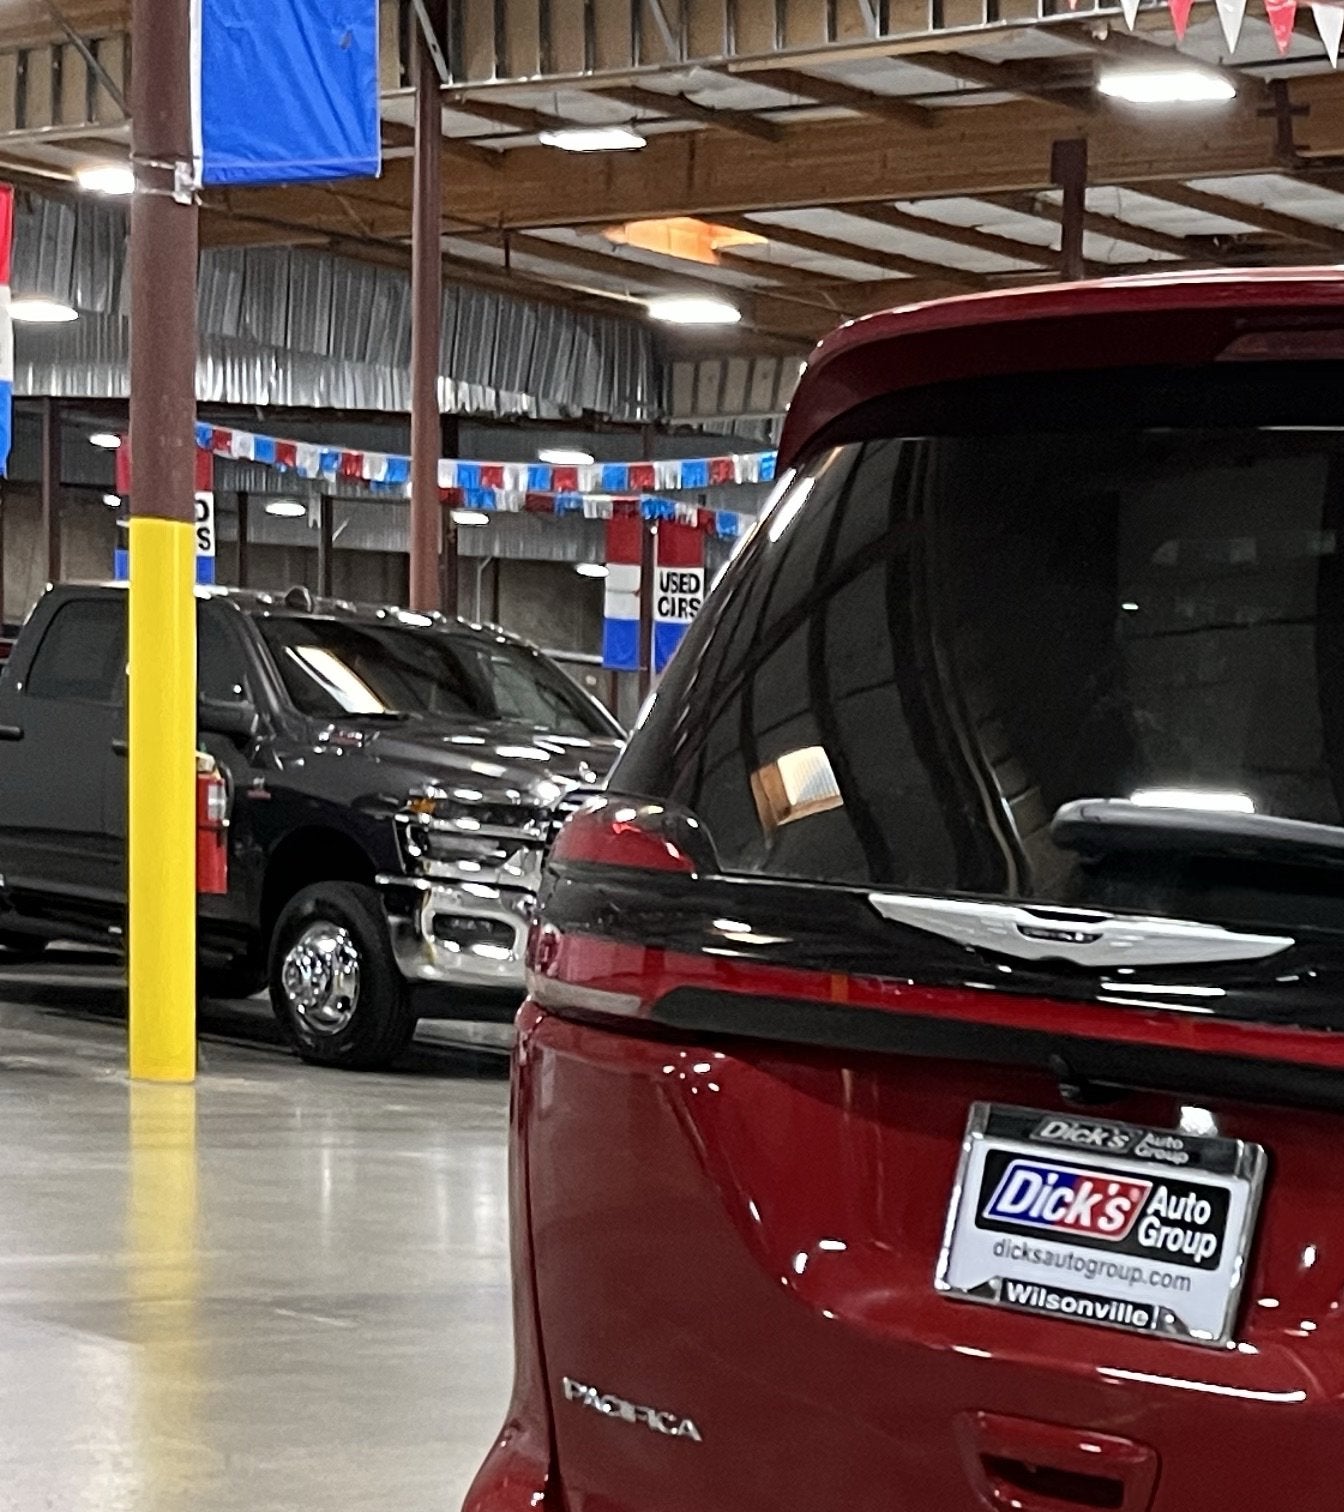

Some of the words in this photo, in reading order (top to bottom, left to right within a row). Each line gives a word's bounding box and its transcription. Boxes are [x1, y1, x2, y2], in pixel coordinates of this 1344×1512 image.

[660, 571, 700, 594] USED
[1040, 1120, 1131, 1149] Dick's
[1134, 1144, 1190, 1165] Group
[1145, 1133, 1185, 1150] Auto
[996, 1168, 1133, 1231] Dick's
[1147, 1185, 1212, 1225] Auto
[1138, 1216, 1218, 1263] Group
[993, 1238, 1192, 1292] dicksautogroup.com
[1006, 1281, 1150, 1328] Wilsonville
